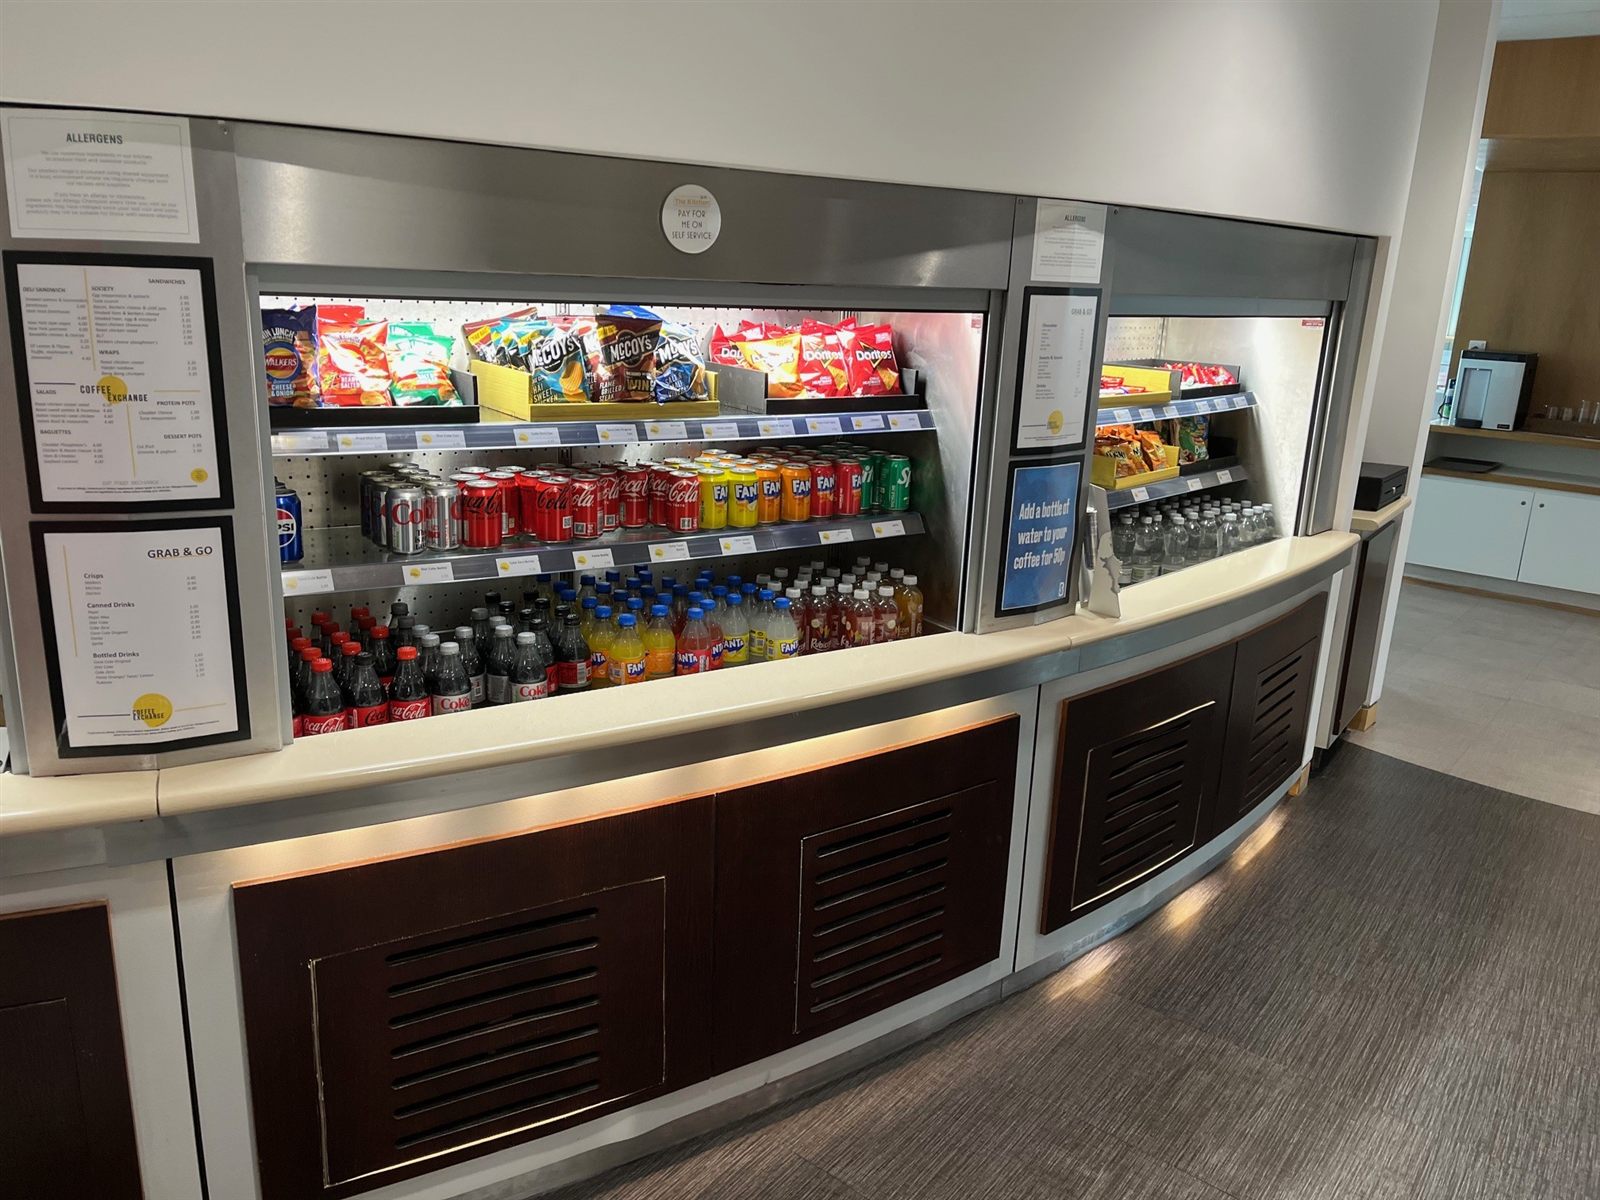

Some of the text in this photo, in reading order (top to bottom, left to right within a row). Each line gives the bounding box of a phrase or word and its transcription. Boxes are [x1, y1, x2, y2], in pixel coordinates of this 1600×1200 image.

[66, 133, 123, 145] ALLERGENS
[678, 209, 705, 218] PAY FOR
[681, 220, 703, 228] ME ON
[672, 231, 712, 240] SELF SERVICE
[271, 327, 295, 338] LUNCH
[803, 350, 843, 361] Doritos
[856, 349, 892, 361] Doritos
[79, 385, 111, 395] COFFEE
[107, 393, 148, 403] EXCHANGE
[763, 480, 781, 496] FAN
[792, 478, 811, 494] FAN
[816, 474, 835, 491] FAN
[669, 479, 699, 503] Cola
[735, 481, 759, 501] FAN
[1018, 498, 1071, 520] Add a bottle of
[277, 523, 294, 532] PSI
[1018, 526, 1067, 545] water to your
[147, 546, 213, 559] GRAB & GO
[1013, 547, 1066, 570] coffee for 50p
[723, 638, 744, 649] ANTA
[591, 653, 606, 663] NTA
[678, 652, 698, 663] ANTA
[520, 684, 547, 698] Coke
[441, 696, 470, 710] Coke
[392, 701, 428, 719] ca-Cola
